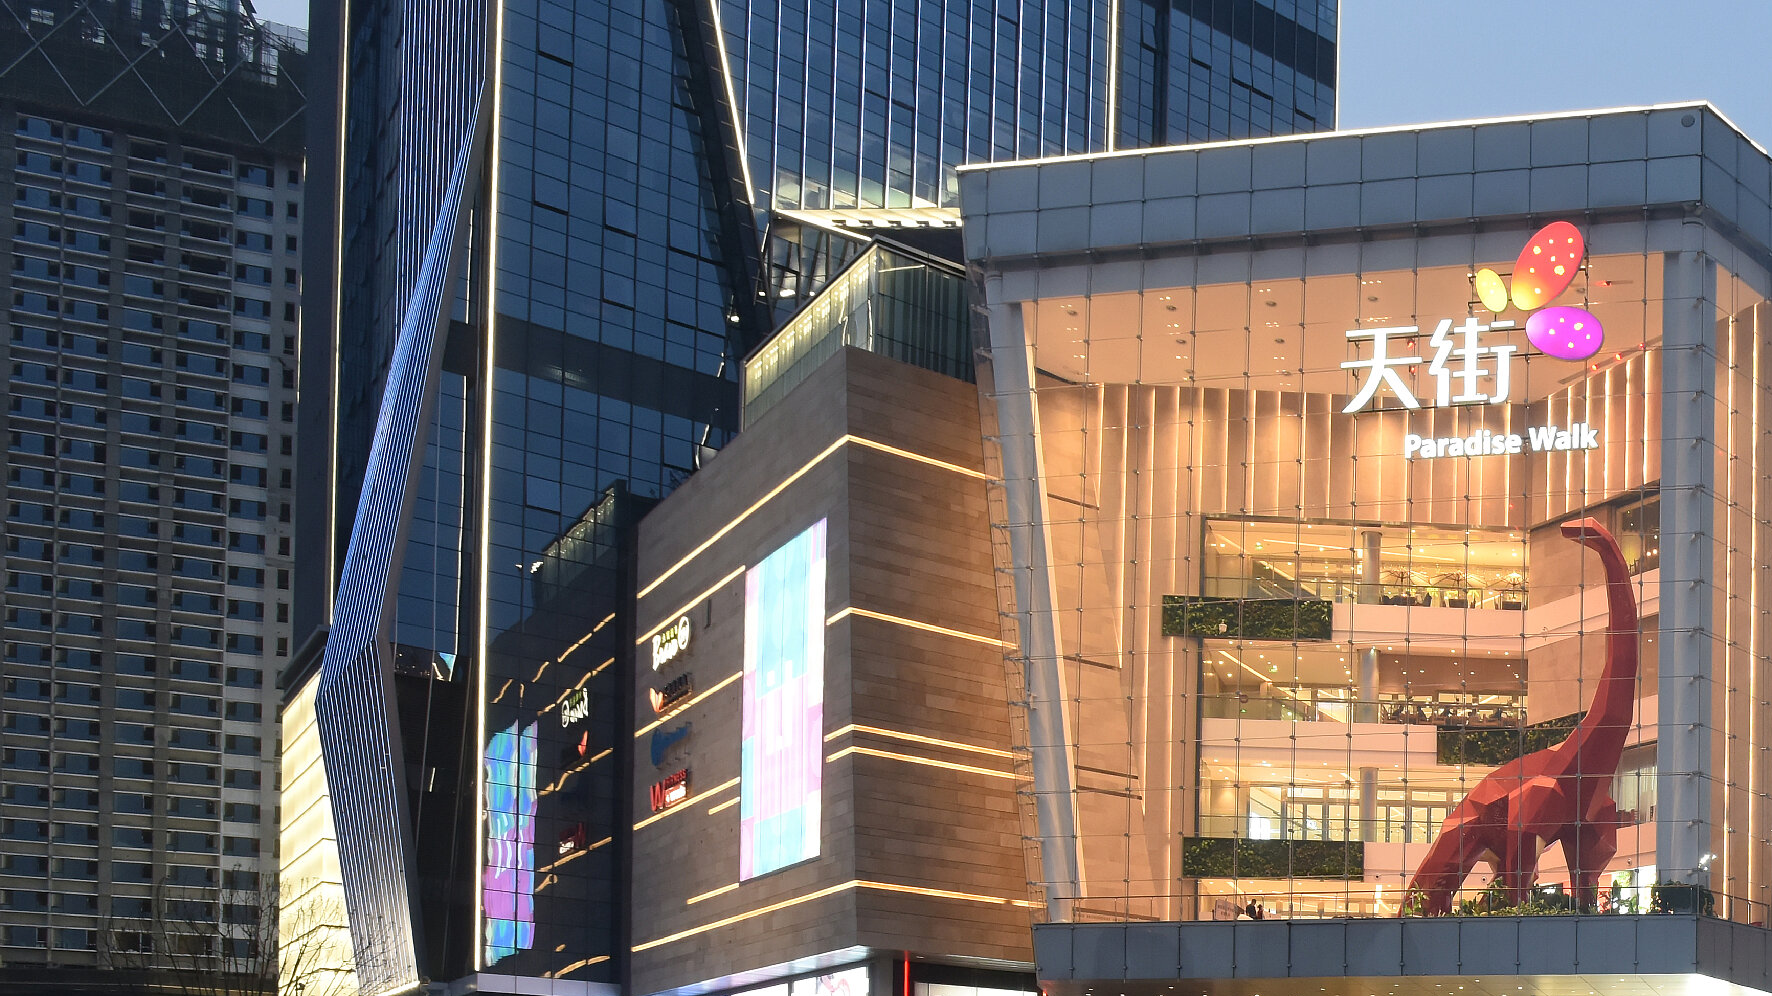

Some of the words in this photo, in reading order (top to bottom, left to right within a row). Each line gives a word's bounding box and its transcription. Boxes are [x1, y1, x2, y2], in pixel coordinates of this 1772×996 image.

[1341, 317, 1517, 414] 天街
[1404, 429, 1522, 459] Paradise
[1528, 422, 1600, 452] Walk
